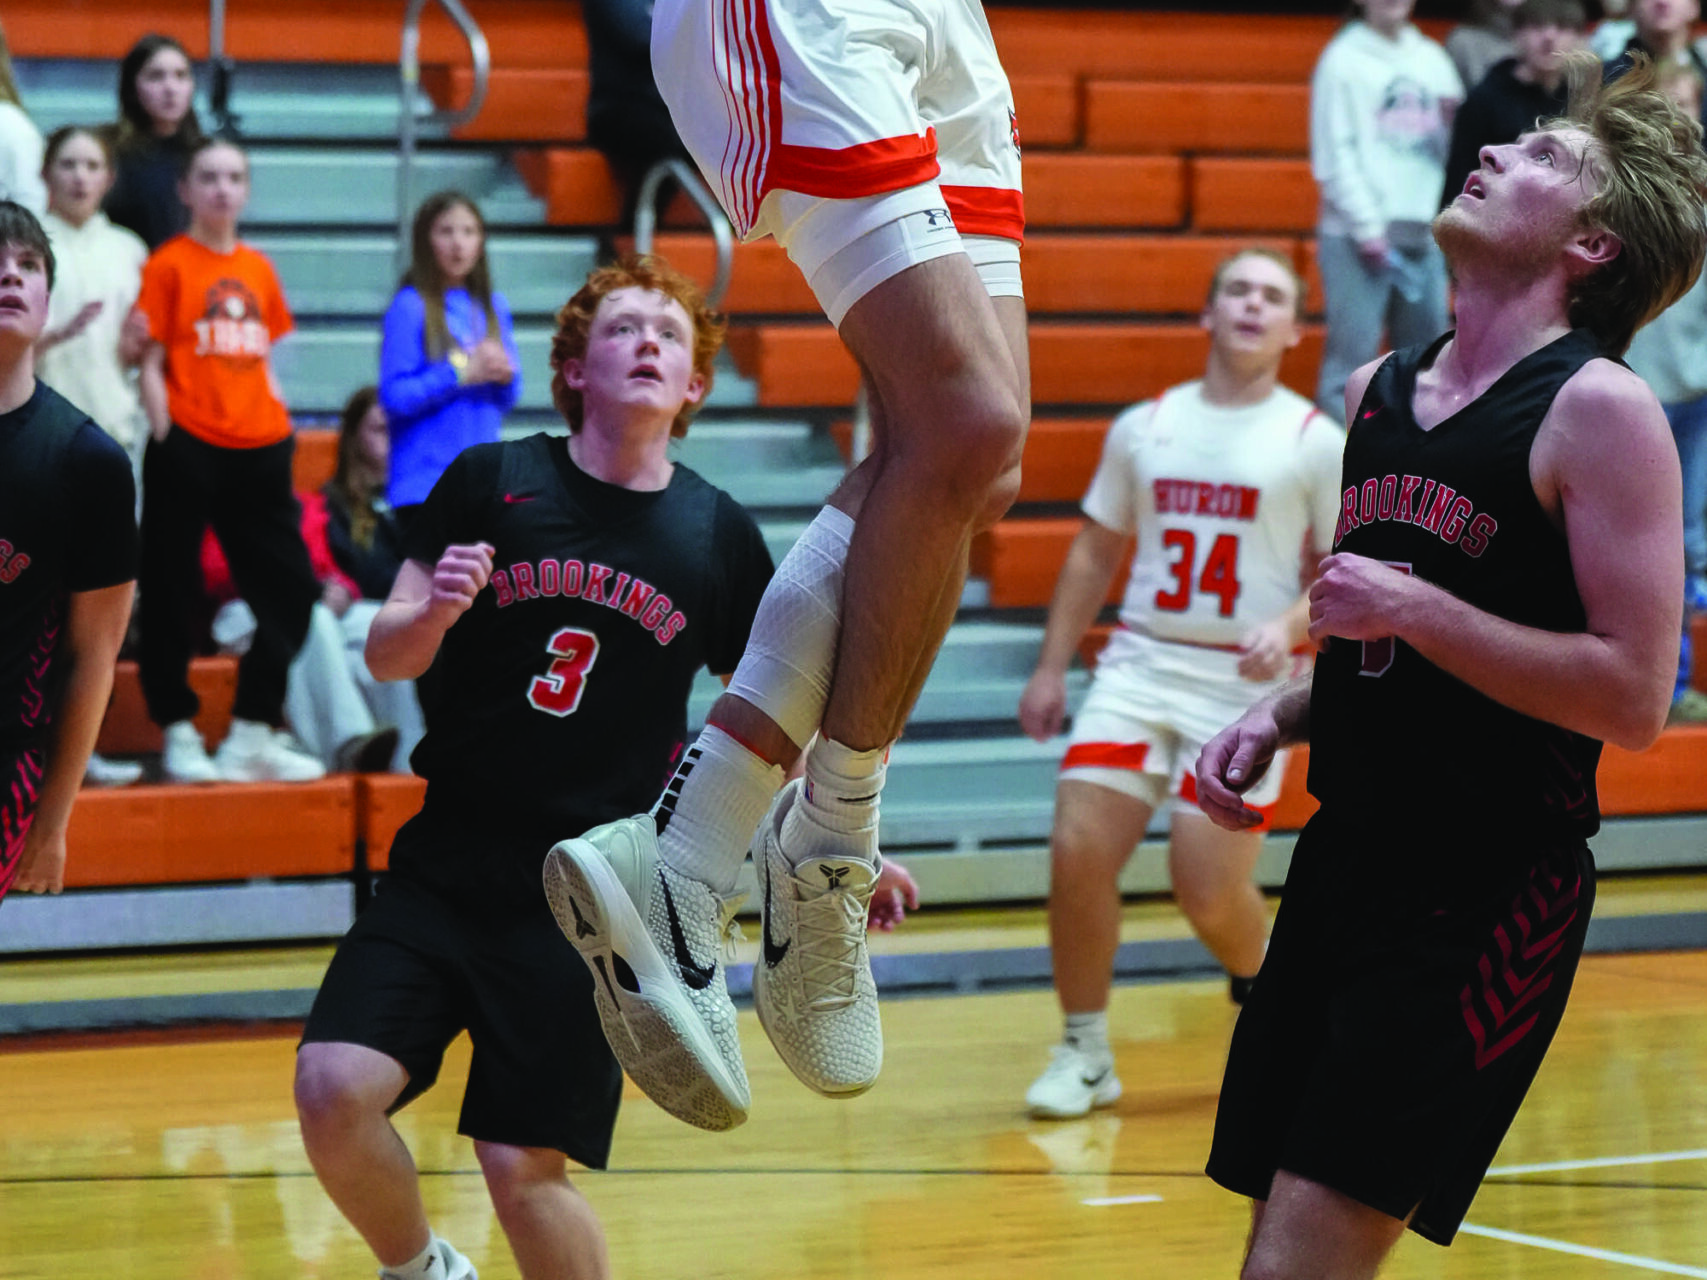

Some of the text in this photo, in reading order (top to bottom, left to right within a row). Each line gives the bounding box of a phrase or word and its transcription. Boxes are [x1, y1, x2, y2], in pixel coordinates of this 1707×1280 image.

[1154, 478, 1259, 522] HURON
[490, 559, 687, 646] BROOKINGS
[1154, 528, 1241, 618] 34
[526, 624, 600, 718] 3
